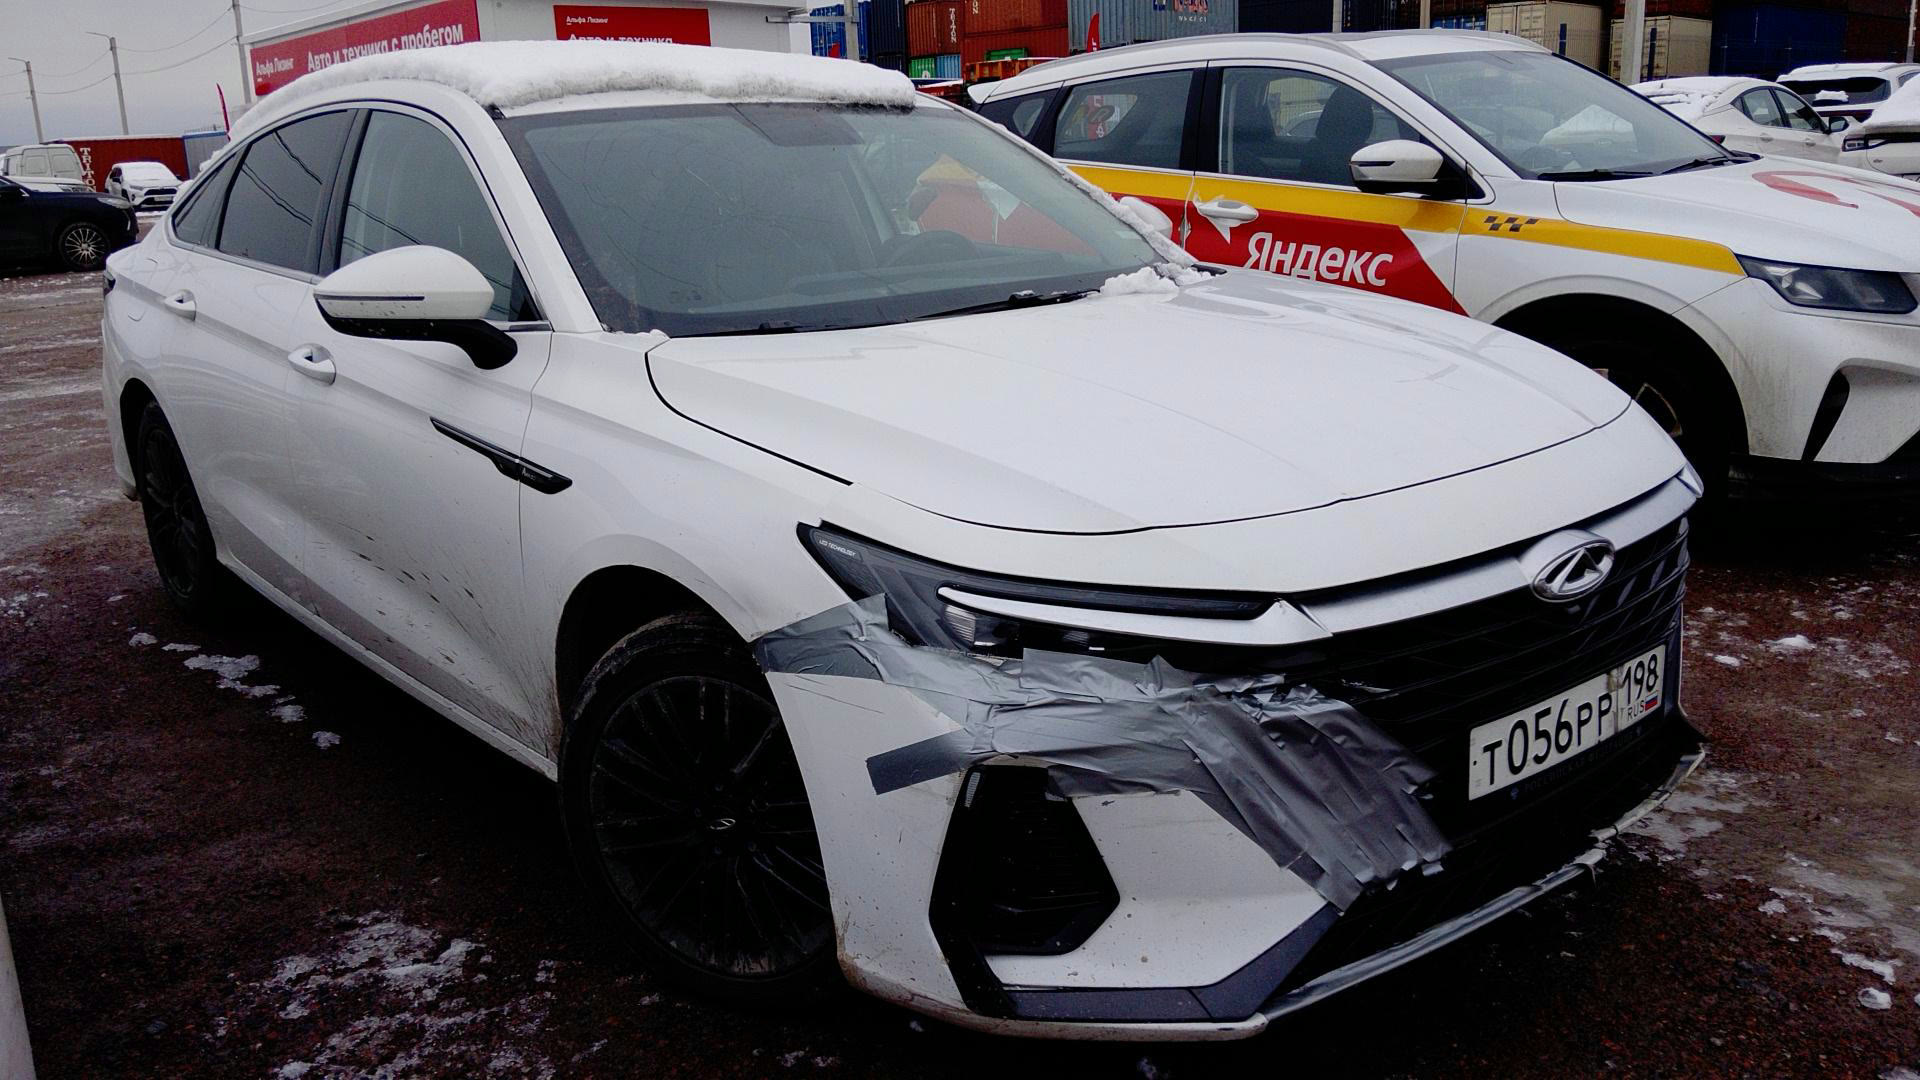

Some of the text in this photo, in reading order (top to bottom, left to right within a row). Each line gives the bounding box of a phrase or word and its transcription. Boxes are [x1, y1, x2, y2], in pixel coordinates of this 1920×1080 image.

[256, 60, 274, 78] Альфа
[307, 23, 464, 73] Авто и техника с пробегом
[1245, 231, 1394, 287] Яндекс
[1620, 653, 1660, 705] 198
[1627, 698, 1646, 722] RUS
